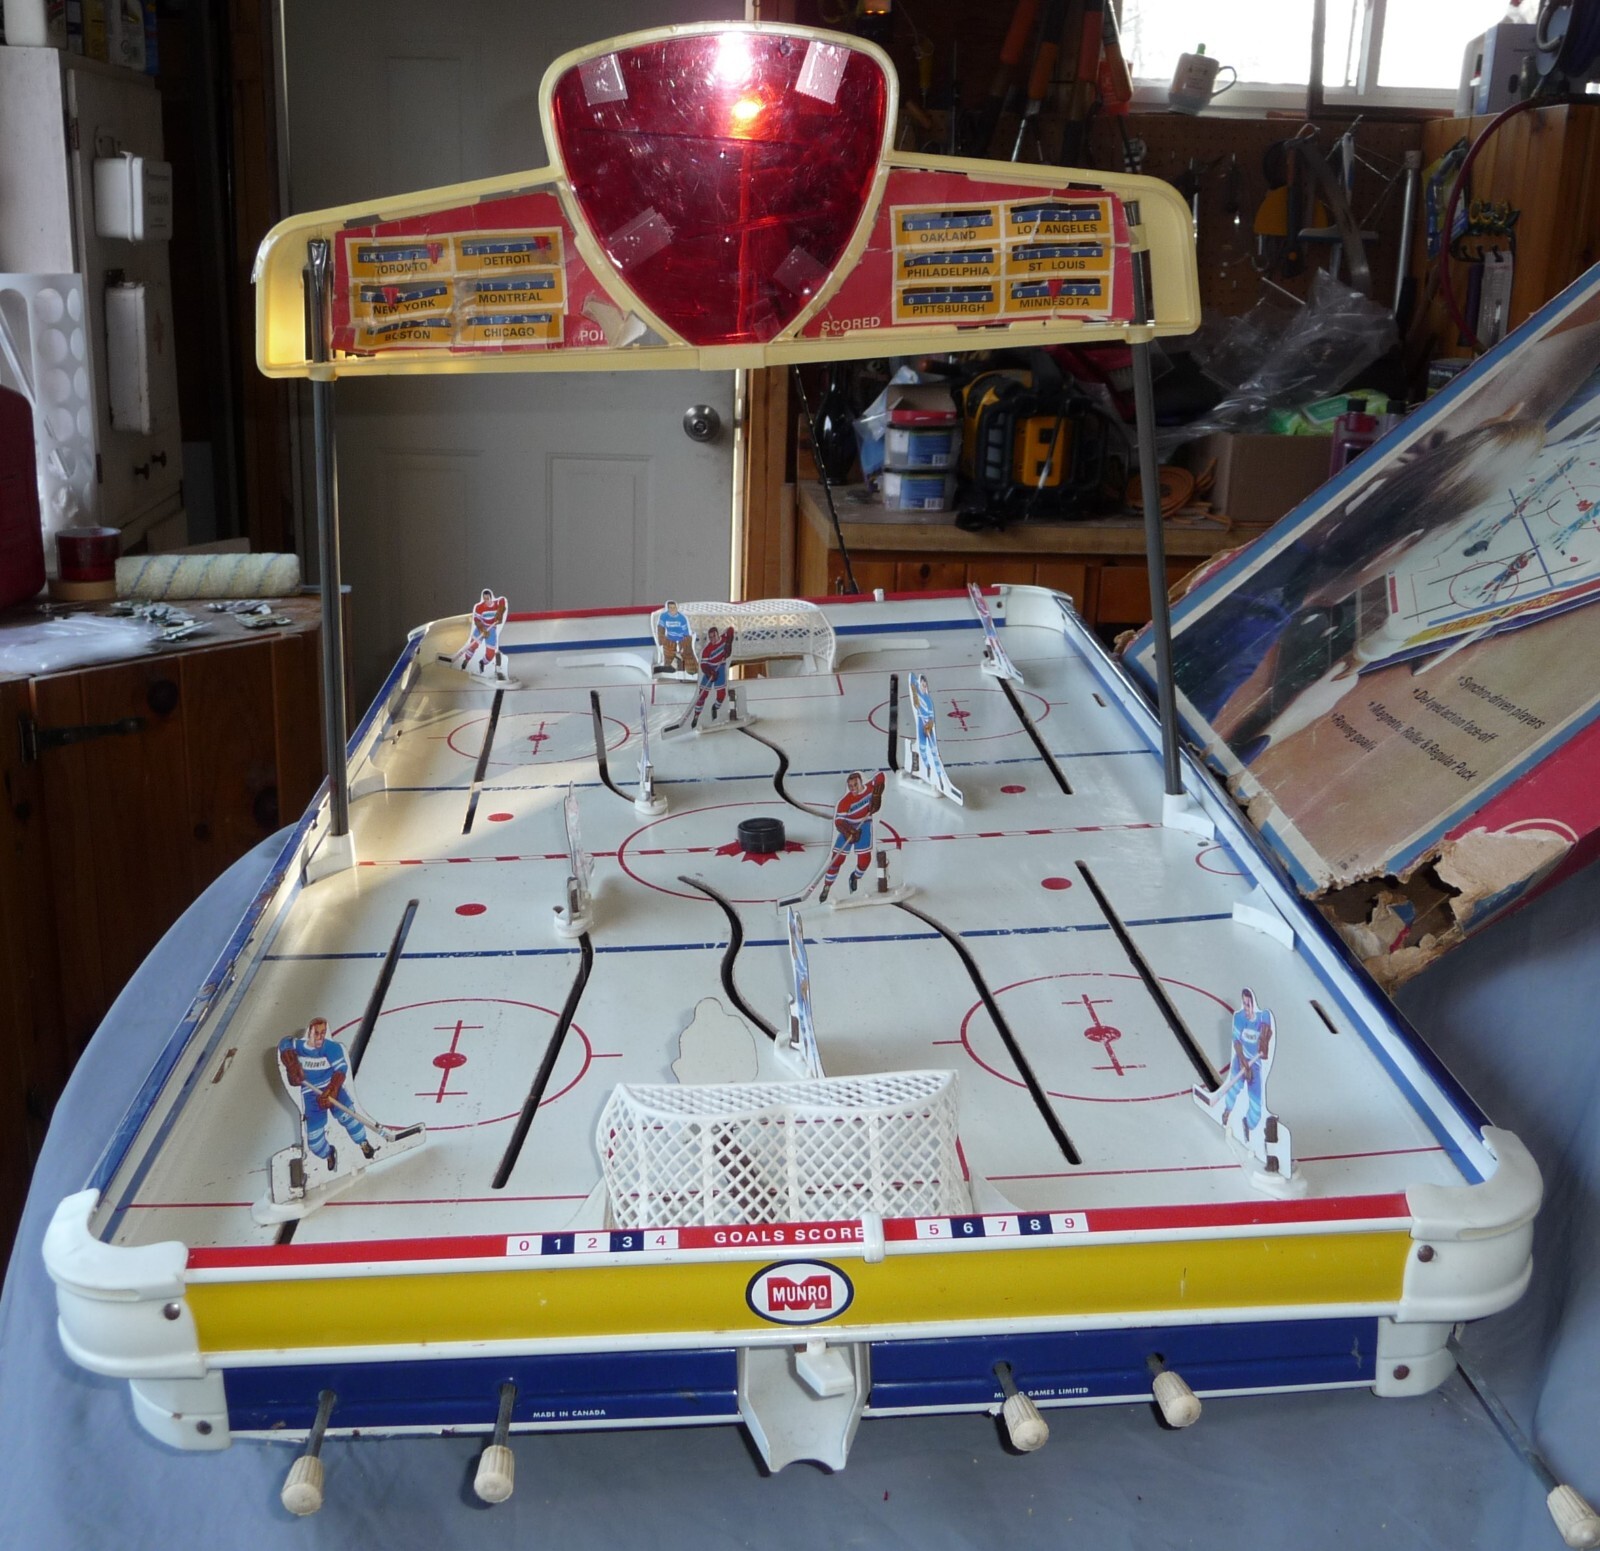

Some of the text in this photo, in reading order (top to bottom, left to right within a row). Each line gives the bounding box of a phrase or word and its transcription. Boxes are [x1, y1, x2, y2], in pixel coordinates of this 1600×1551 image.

[1044, 224, 1098, 234] ANGELES
[920, 230, 976, 243] OAKLAND
[484, 254, 531, 266] DETROIT
[1029, 260, 1085, 271] ST LOUIS
[375, 262, 428, 274] TORONTO
[907, 267, 990, 278] PHILADELPHIA
[478, 292, 543, 303] MONTREAL
[1020, 297, 1090, 308] MINNESOTA
[373, 299, 436, 314] NEW YORK
[912, 304, 985, 314] PITTSBURGH
[822, 316, 880, 331] SCORED
[385, 330, 431, 341] BOSTON
[484, 327, 534, 338] CHICAGO
[580, 330, 604, 342] POI
[1460, 677, 1546, 730] Synchro-driven players
[1331, 714, 1357, 738] Roving
[1440, 709, 1465, 727] action
[1461, 720, 1499, 743] face-off
[1400, 726, 1424, 745] Roller
[1425, 744, 1457, 768] Regular
[1452, 762, 1478, 781] Puck
[929, 1218, 1075, 1235] 5 6 7 8 9
[714, 1228, 864, 1243] GOALS SCORE
[519, 1235, 666, 1251] 0 1 2 3 4
[772, 1285, 828, 1302] MUNRO
